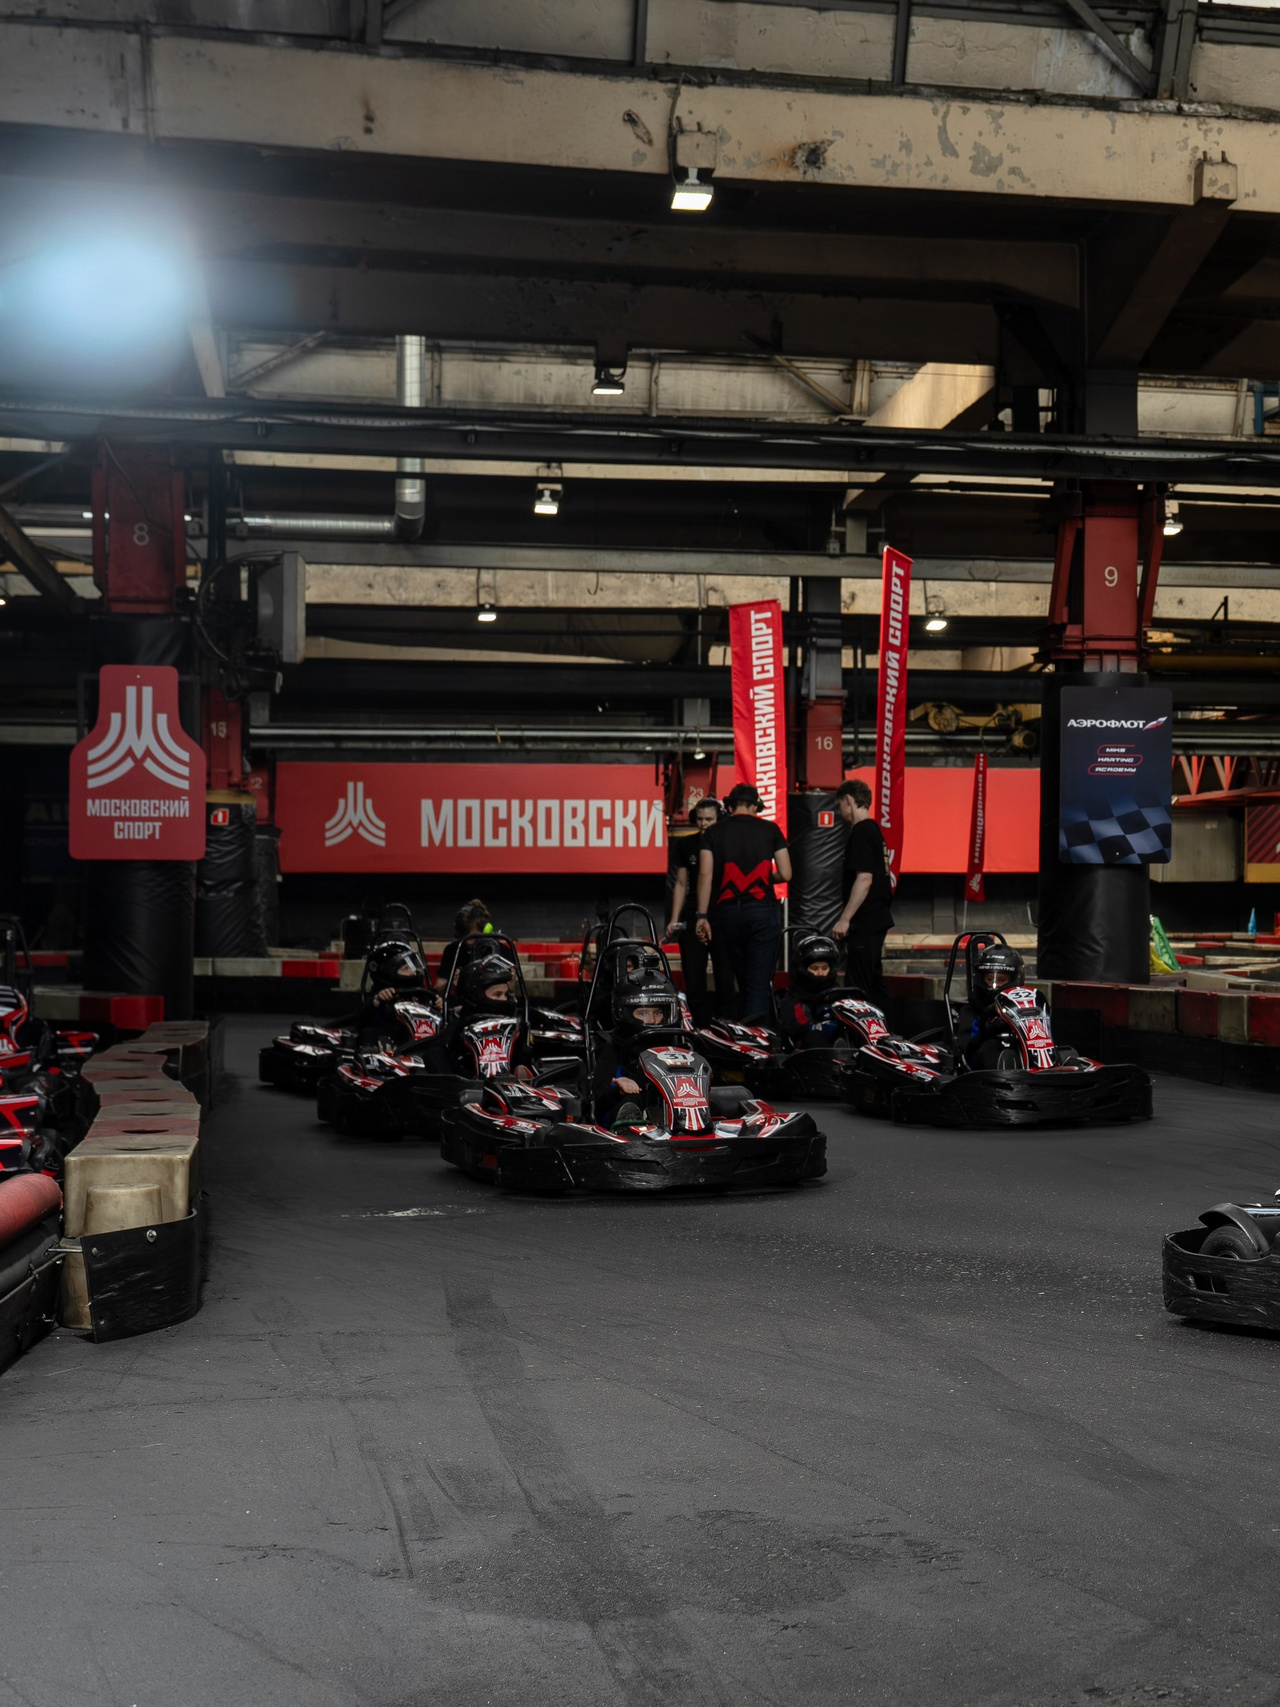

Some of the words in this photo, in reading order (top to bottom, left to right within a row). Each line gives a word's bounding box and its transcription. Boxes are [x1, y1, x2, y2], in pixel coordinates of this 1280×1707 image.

[132, 523, 150, 546] 8
[1104, 565, 1119, 588] 9
[888, 560, 905, 647] СПОРТ
[750, 610, 775, 681] СПОРТ
[1067, 718, 1146, 729] АЭРОФЛОТ
[814, 736, 834, 751] 16
[880, 650, 901, 829] МОСКОВСКИЙ
[86, 796, 190, 818] МОСКОВСКИЙ
[114, 821, 162, 840] СПОРТ
[420, 798, 664, 848] МОСКОВСКИ
